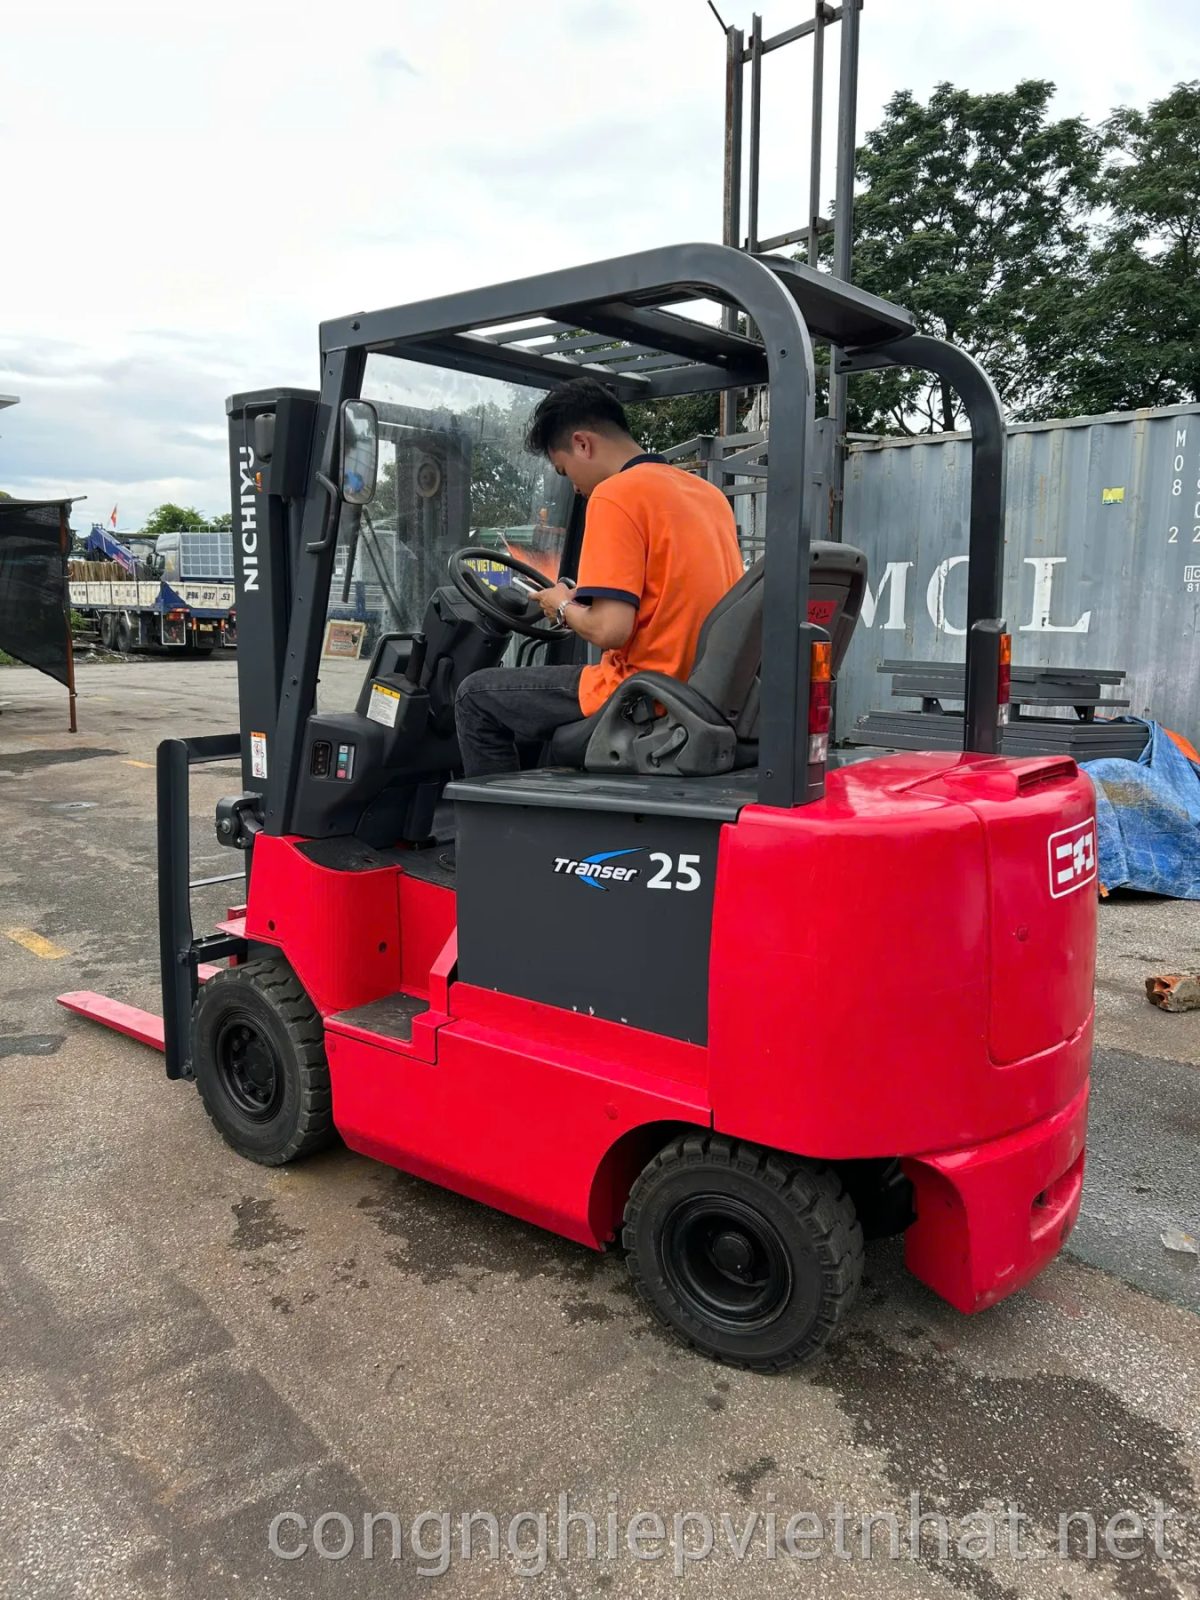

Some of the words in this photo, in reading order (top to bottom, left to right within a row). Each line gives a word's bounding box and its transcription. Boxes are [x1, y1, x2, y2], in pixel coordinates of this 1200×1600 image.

[239, 446, 260, 593] NICHIYU
[553, 857, 638, 882] Transer
[646, 852, 702, 892] 25
